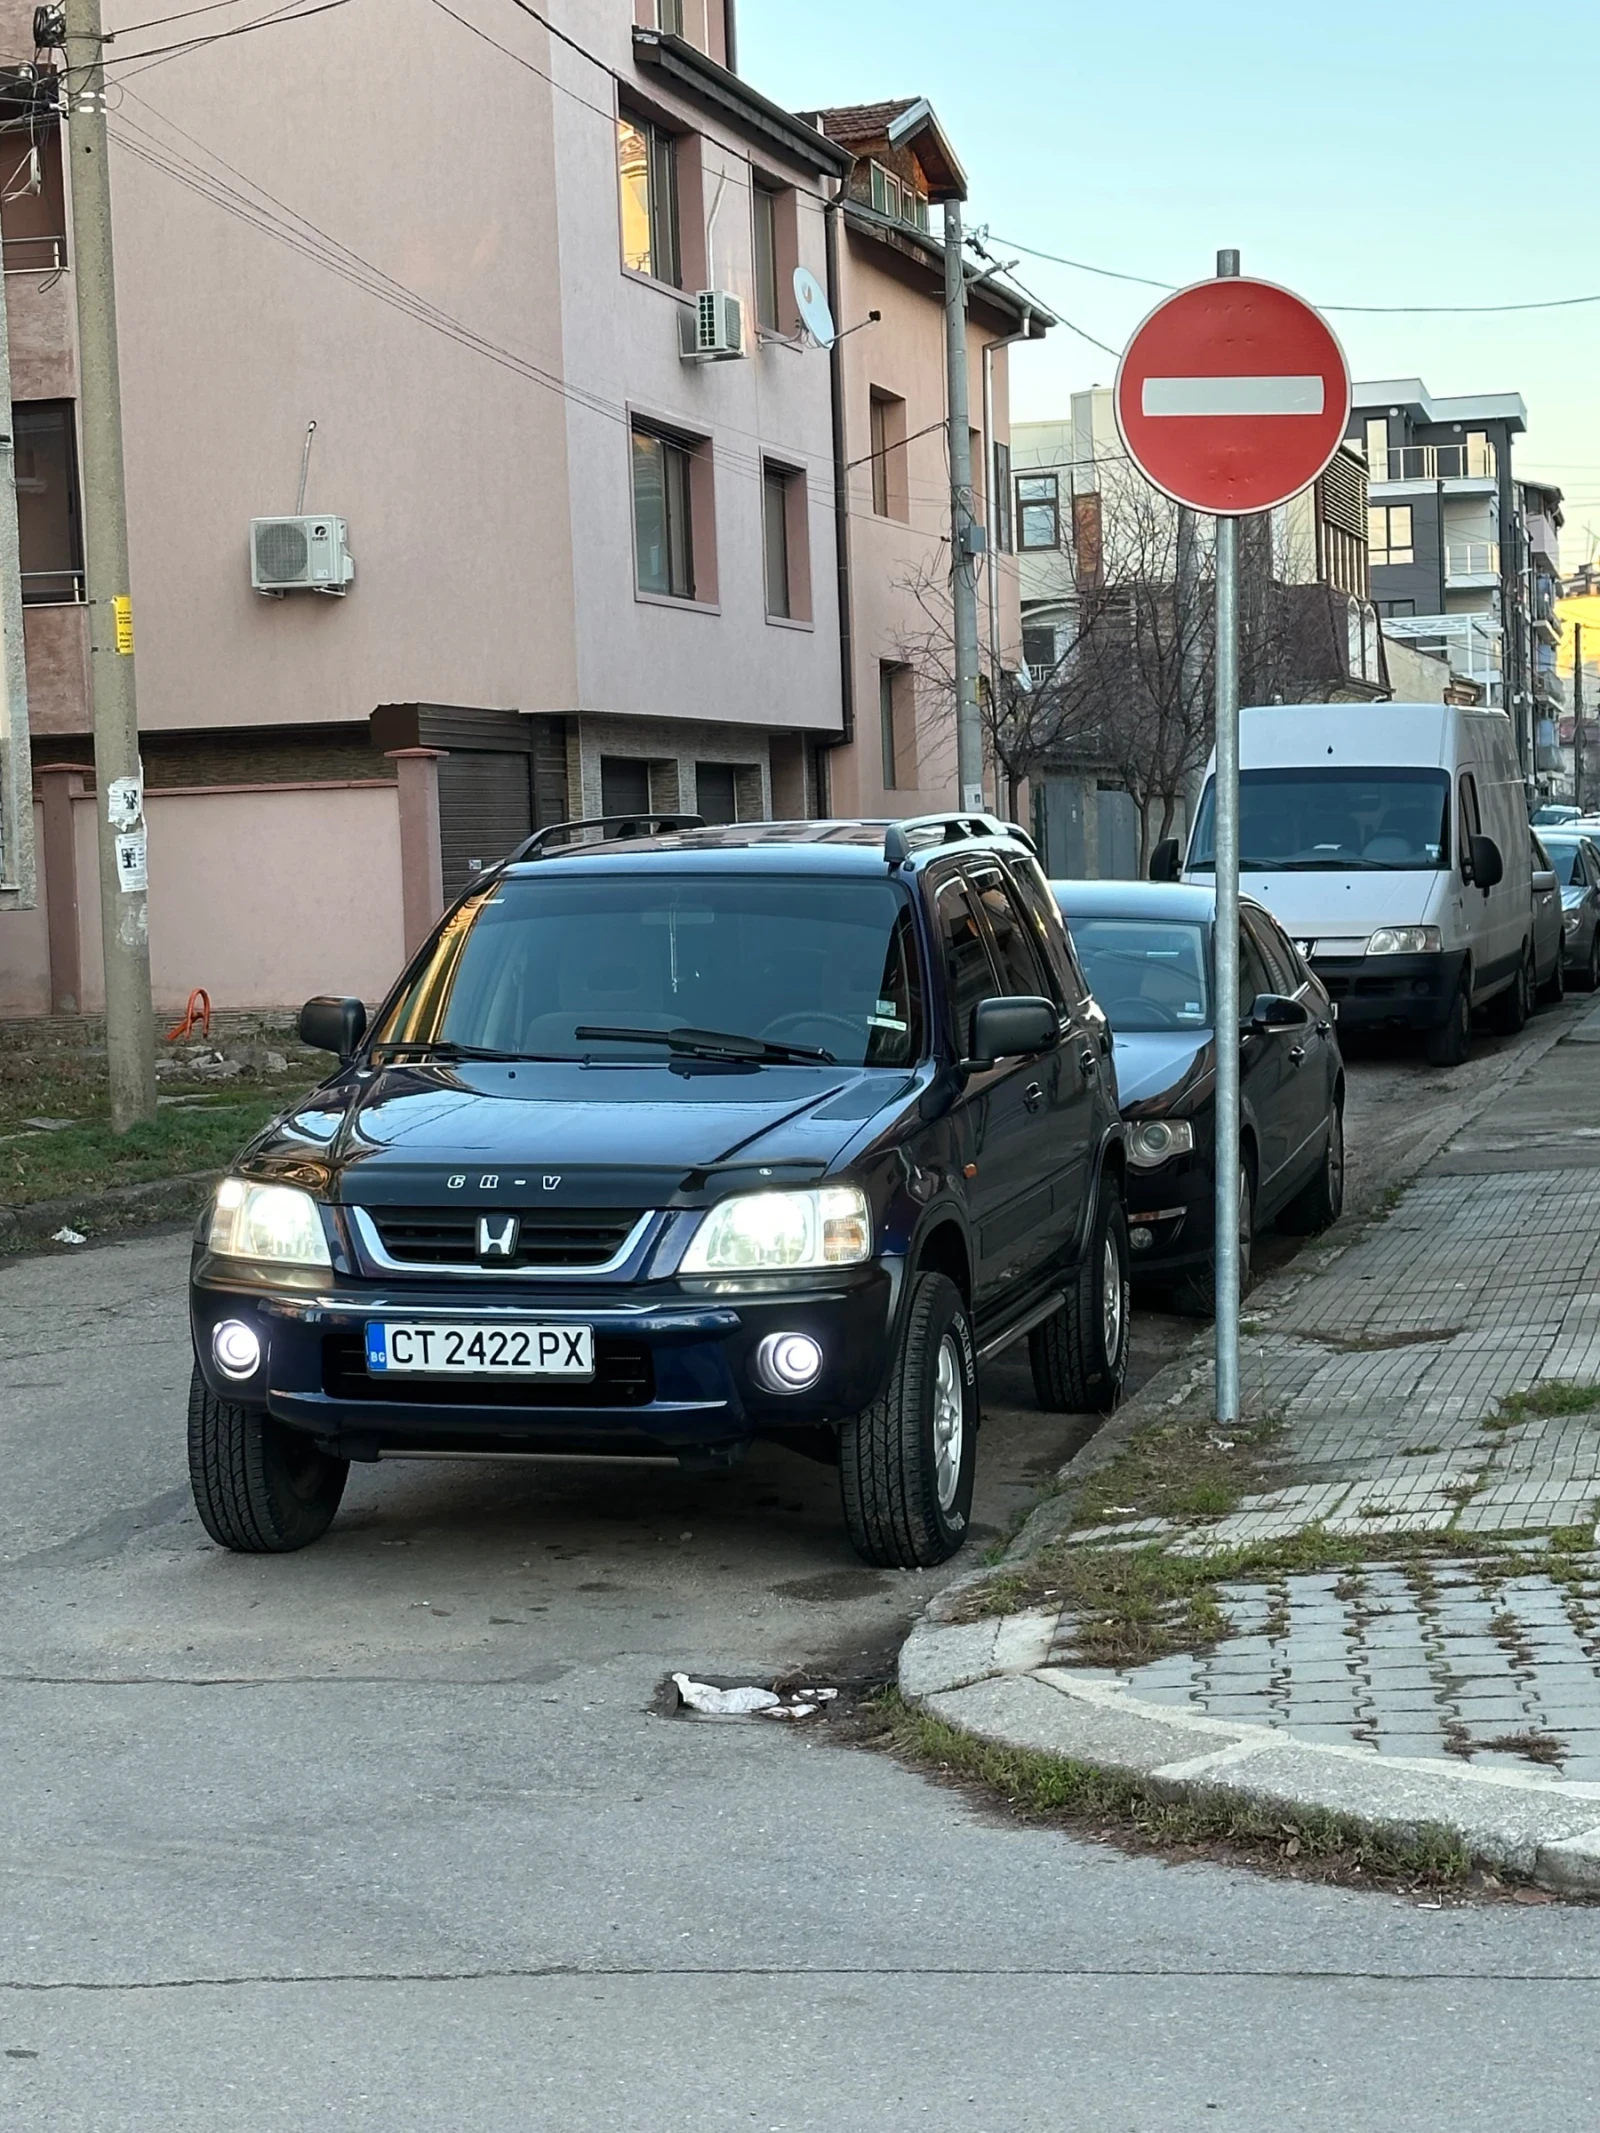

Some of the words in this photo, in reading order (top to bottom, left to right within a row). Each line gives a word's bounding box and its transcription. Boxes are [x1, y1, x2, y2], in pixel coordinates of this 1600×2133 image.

[370, 1351, 386, 1363] BG
[391, 1329, 436, 1365] CT
[444, 1331, 531, 1366] 2422
[538, 1331, 585, 1367] PX
